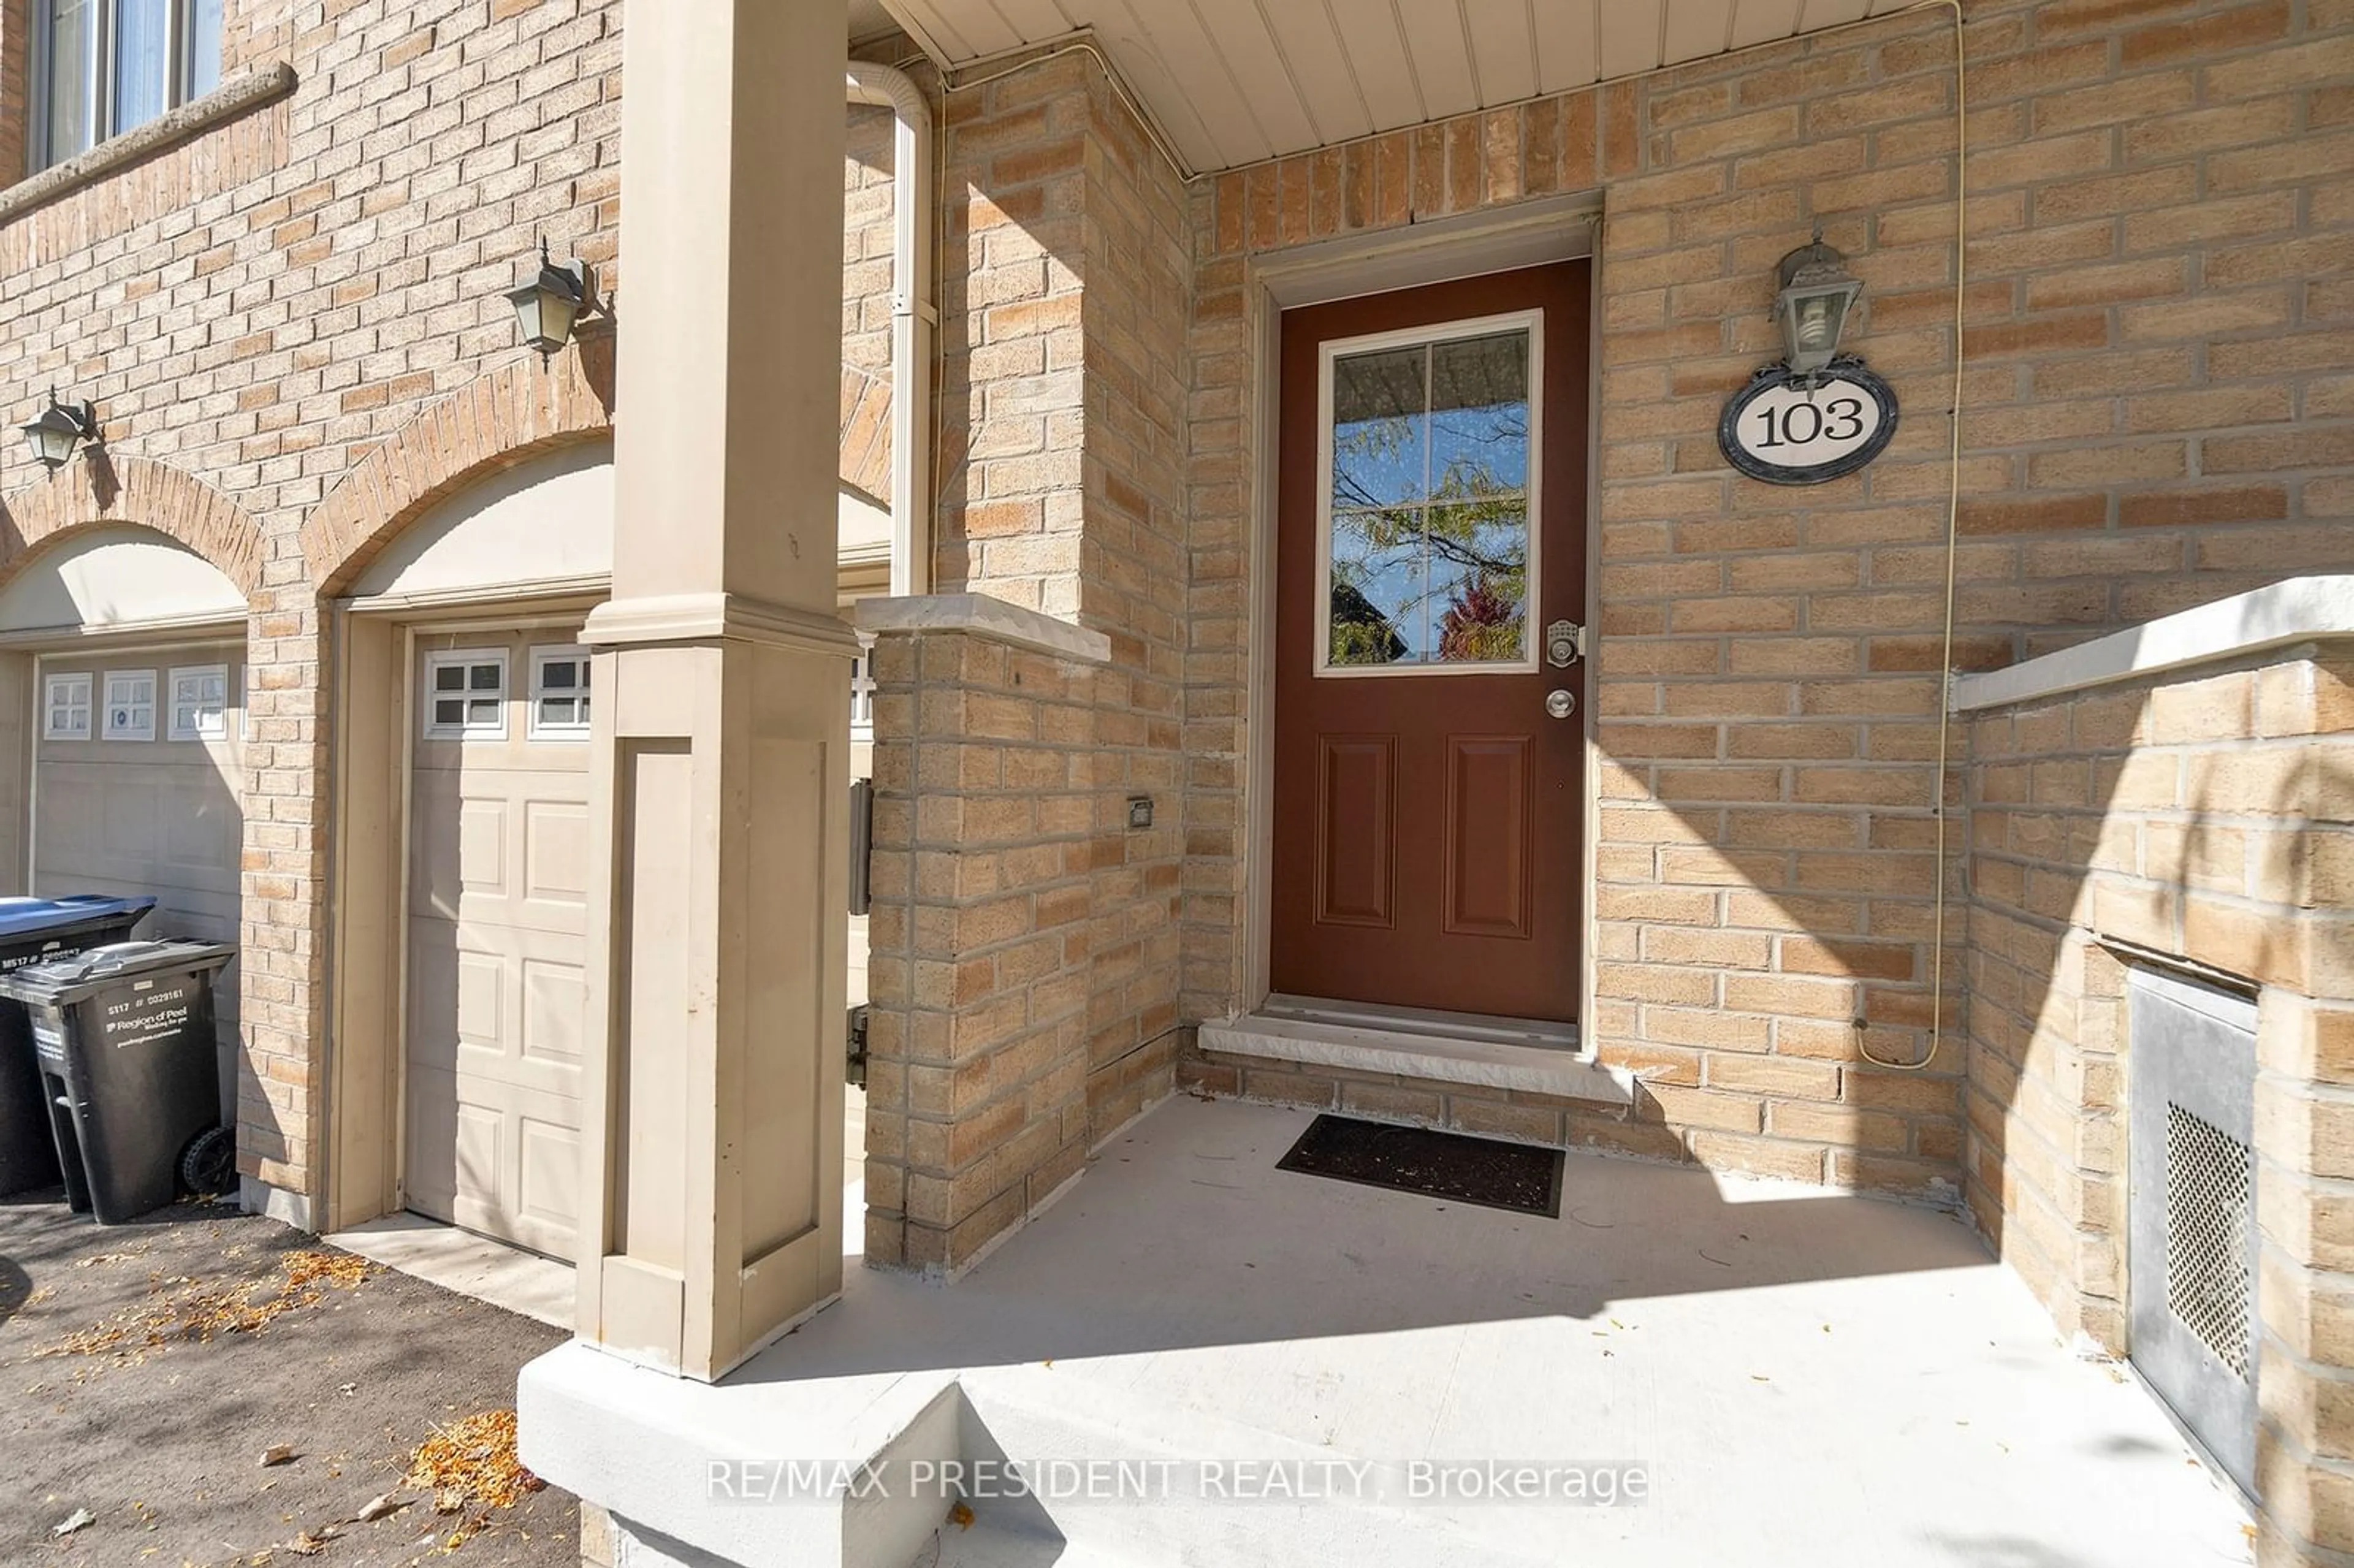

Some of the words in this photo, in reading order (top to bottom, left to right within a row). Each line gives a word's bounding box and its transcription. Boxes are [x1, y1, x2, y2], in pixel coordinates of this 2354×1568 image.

[1756, 398, 1864, 448] 103
[118, 1016, 155, 1030] Region
[156, 1011, 166, 1021] of
[166, 1006, 188, 1019] Peel
